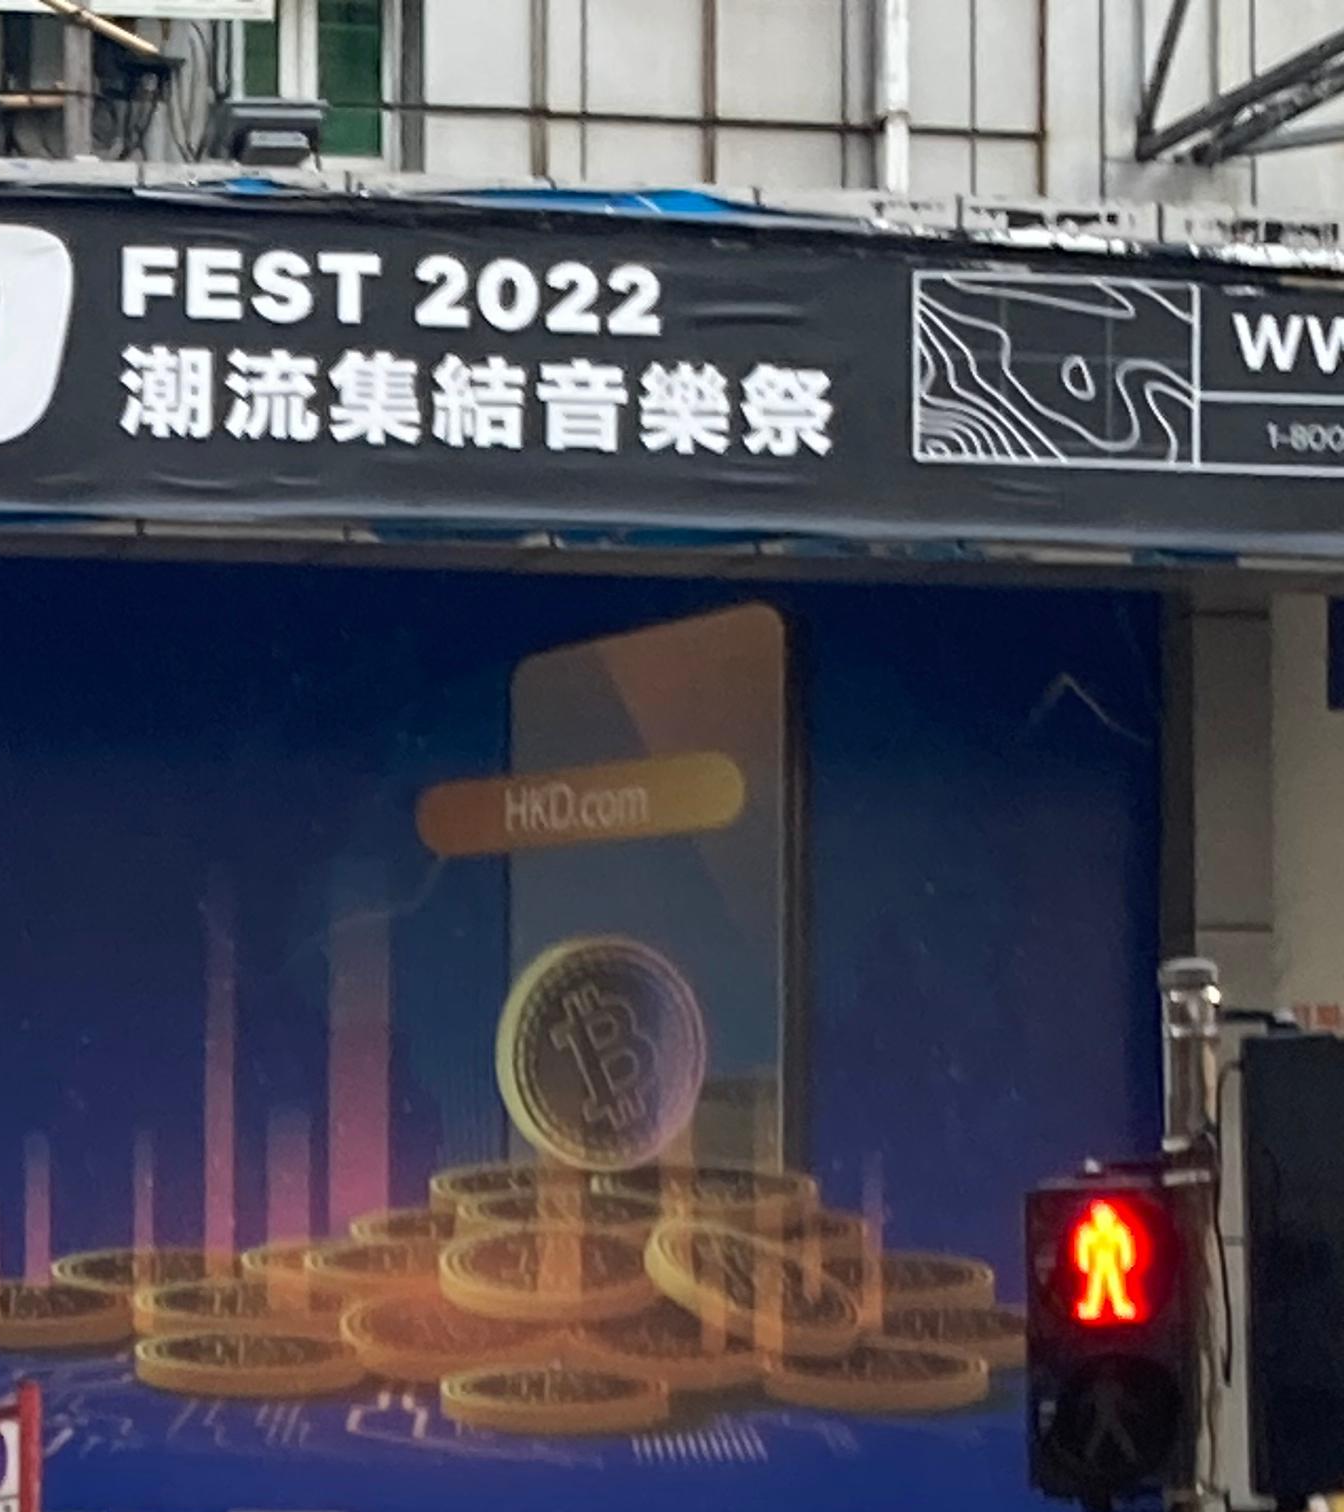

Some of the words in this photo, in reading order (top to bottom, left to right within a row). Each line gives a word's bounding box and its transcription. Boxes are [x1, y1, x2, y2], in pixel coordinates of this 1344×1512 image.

[119, 245, 381, 325] FEST
[413, 255, 663, 336] 2022
[118, 345, 833, 457] 潮流集結音樂祭
[504, 783, 650, 831] HKD.com
